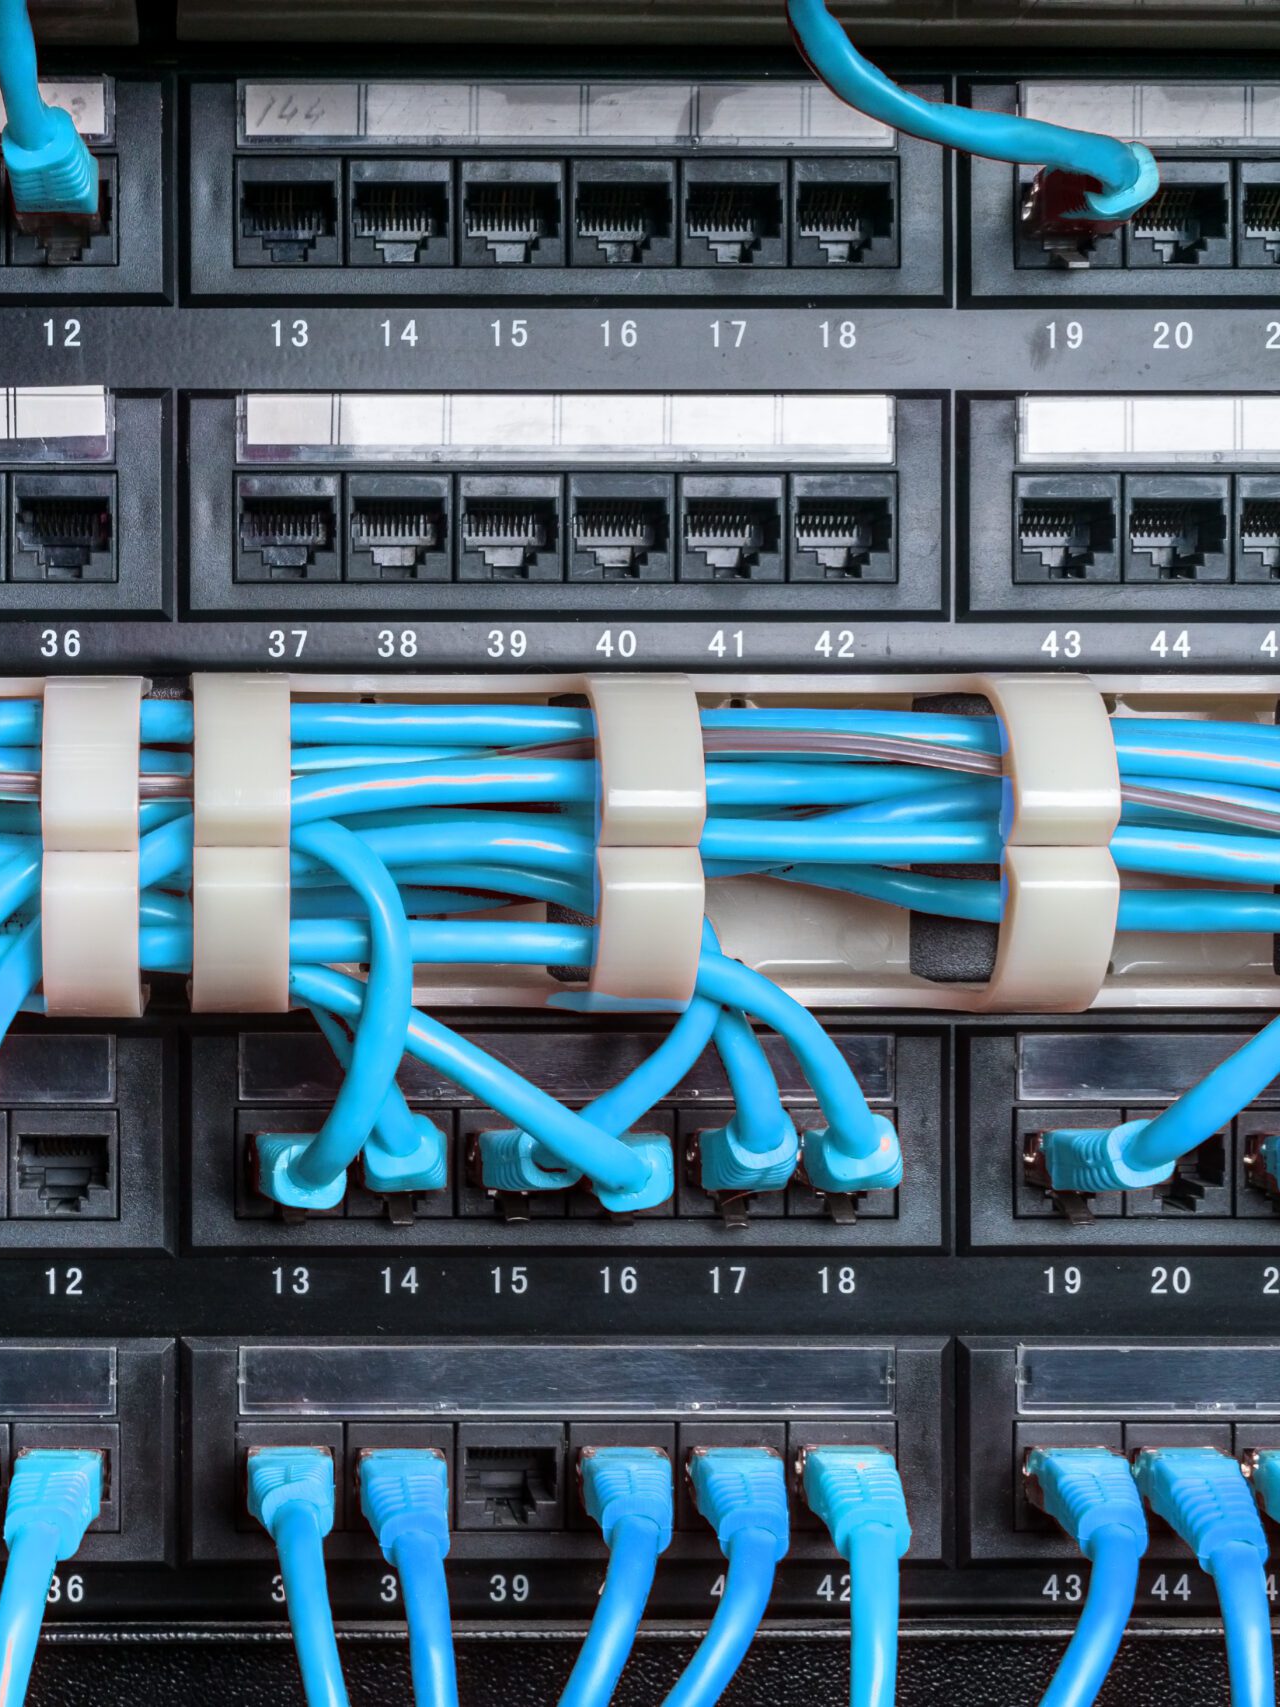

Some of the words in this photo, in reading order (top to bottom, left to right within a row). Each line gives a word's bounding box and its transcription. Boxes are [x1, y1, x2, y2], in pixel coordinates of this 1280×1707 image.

[43, 318, 81, 347] 12
[271, 319, 309, 348] 13
[380, 319, 419, 347] 14
[490, 319, 528, 347] 15
[600, 320, 637, 348] 16
[710, 320, 747, 348] 17
[819, 321, 856, 349] 18
[1046, 321, 1083, 349] 19
[1153, 321, 1193, 349] 20
[1265, 321, 1280, 349] 2
[40, 628, 81, 657] 36
[268, 629, 308, 658] 37
[377, 629, 418, 658] 38
[487, 629, 527, 658] 39
[595, 630, 637, 658] 40
[707, 630, 743, 658] 41
[814, 630, 855, 658] 42
[1040, 630, 1082, 658] 43
[1150, 630, 1191, 658] 44
[1260, 630, 1279, 658] 4
[45, 1267, 83, 1295] 12
[272, 1266, 310, 1294] 13
[380, 1266, 419, 1294] 14
[490, 1266, 528, 1294] 15
[599, 1266, 638, 1294] 16
[709, 1266, 747, 1294] 17
[817, 1266, 856, 1294] 18
[1043, 1266, 1082, 1295] 19
[1150, 1266, 1192, 1294] 20
[1262, 1266, 1280, 1294] 2
[46, 1574, 84, 1603] 36
[271, 1574, 287, 1602] 3
[380, 1574, 397, 1602] 3
[489, 1574, 529, 1602] 39
[709, 1574, 726, 1599] 4
[816, 1574, 851, 1602] 42
[1042, 1574, 1082, 1602] 43
[1150, 1573, 1192, 1601] 44
[1265, 1573, 1279, 1601] 4
